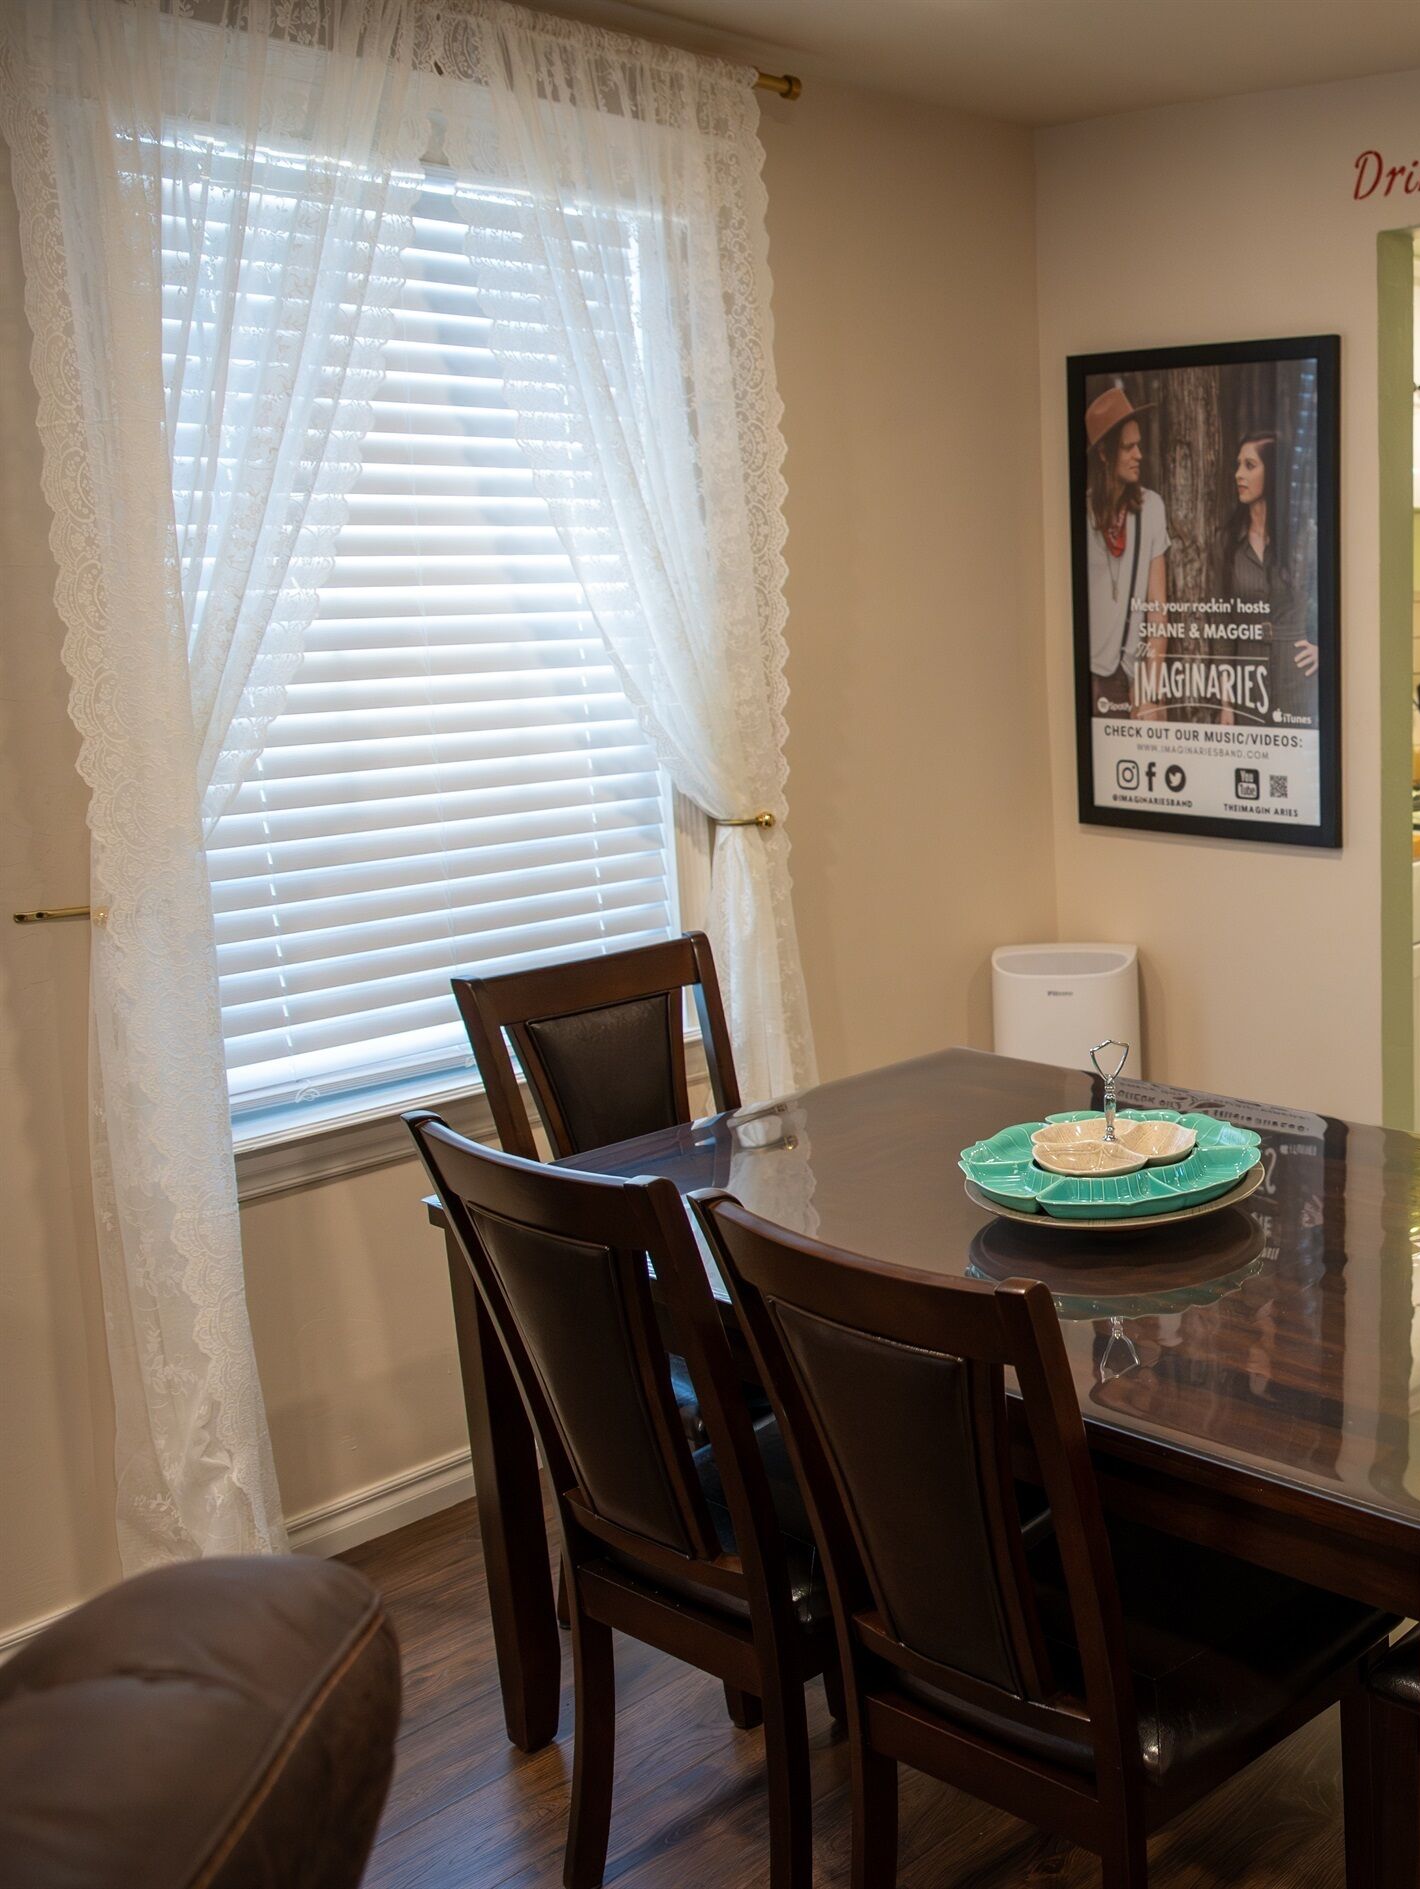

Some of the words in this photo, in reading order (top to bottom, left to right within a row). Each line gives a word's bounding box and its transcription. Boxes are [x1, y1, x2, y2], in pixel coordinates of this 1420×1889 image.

[1131, 597, 1159, 613] Meet
[1162, 600, 1190, 617] your
[1192, 598, 1234, 614] rockin'
[1236, 598, 1271, 614] hosts
[1138, 622, 1185, 638] SHANE
[1188, 623, 1201, 639] &
[1203, 623, 1263, 640] MAGGIE
[1133, 660, 1270, 715] IMAGINARIES
[1282, 713, 1312, 725] iTunes
[1104, 724, 1143, 738] CHECK
[1146, 727, 1171, 740] OUT
[1174, 729, 1200, 742] OUR
[1204, 731, 1303, 748] MUSIC/VIDEOS:
[1274, 807, 1299, 818] ARIES
